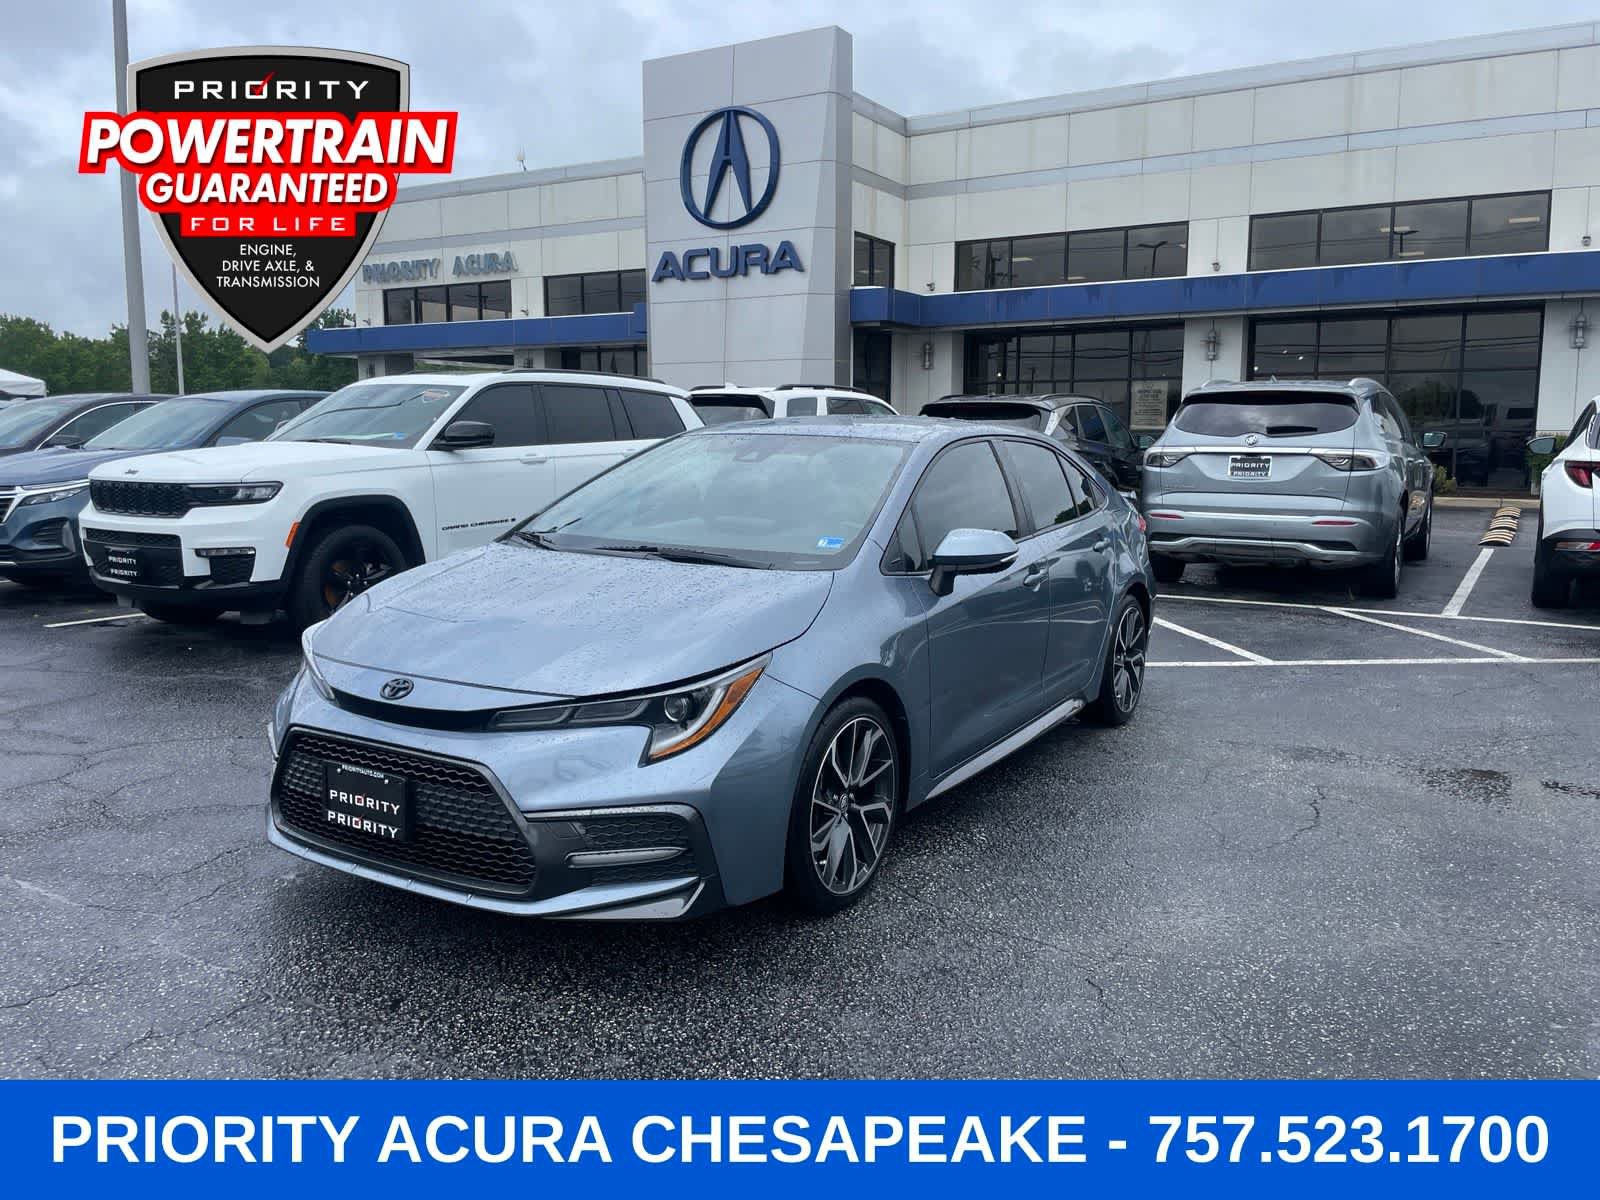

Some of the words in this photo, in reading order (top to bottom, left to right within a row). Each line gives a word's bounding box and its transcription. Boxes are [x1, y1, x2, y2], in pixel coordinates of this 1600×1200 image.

[362, 257, 441, 284] PRIORITY
[452, 250, 518, 276] ACURA
[651, 240, 804, 282] ACURA
[108, 555, 137, 565] PRIORITY
[329, 789, 400, 815] PRIORITY
[327, 810, 398, 839] PRIORITY
